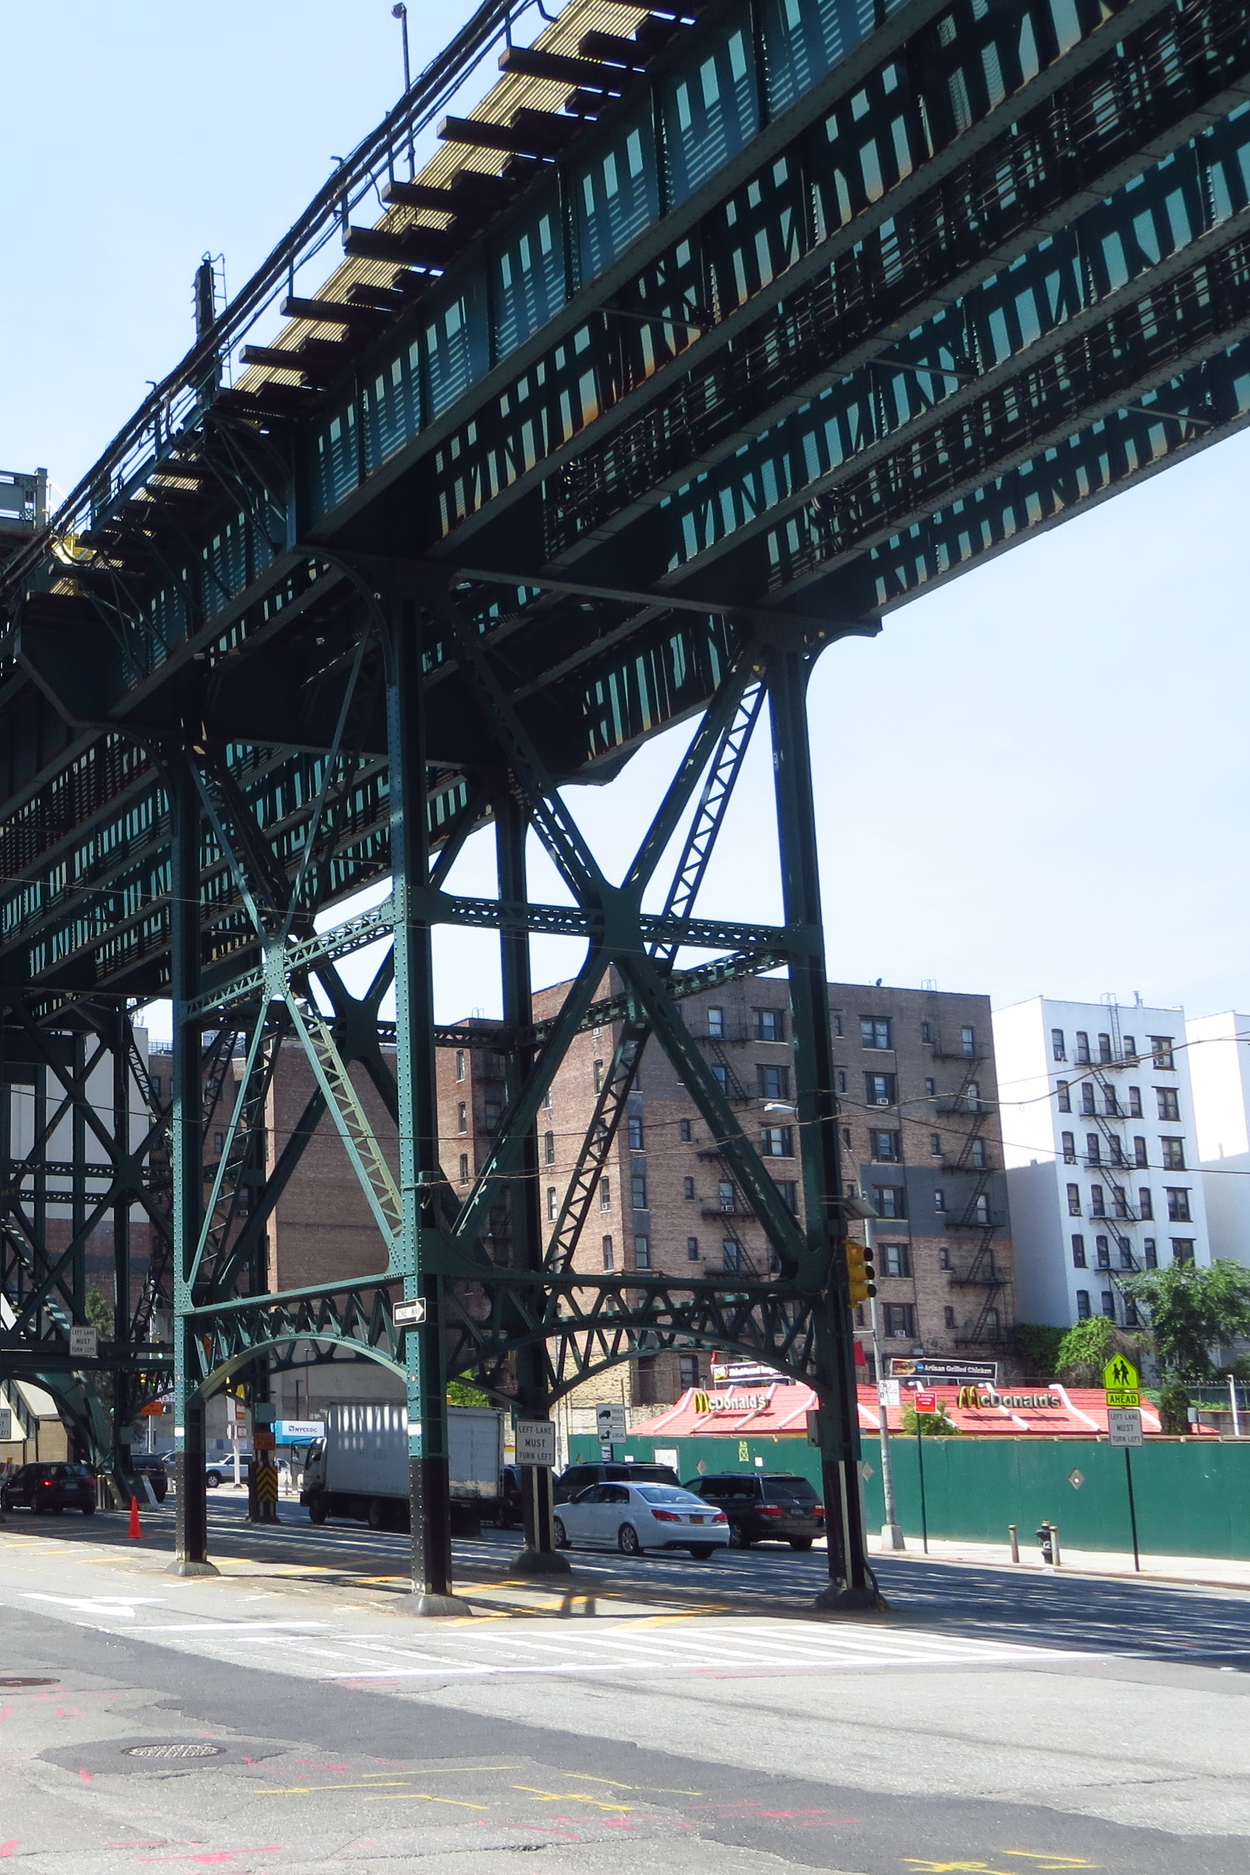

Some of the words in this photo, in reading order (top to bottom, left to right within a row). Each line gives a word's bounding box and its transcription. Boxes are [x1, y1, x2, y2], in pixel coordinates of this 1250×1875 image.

[398, 1309, 407, 1318] ONE
[695, 1391, 768, 1414] McDonald's
[958, 1386, 1060, 1409] McDonald's
[1110, 1394, 1137, 1404] AHEAD
[519, 1425, 533, 1433] LEFT
[1116, 1424, 1134, 1432] MUST
[525, 1438, 546, 1448] MUST
[1112, 1435, 1126, 1443] TURN
[519, 1451, 535, 1460] TURN
[538, 1452, 553, 1461] LEFT
